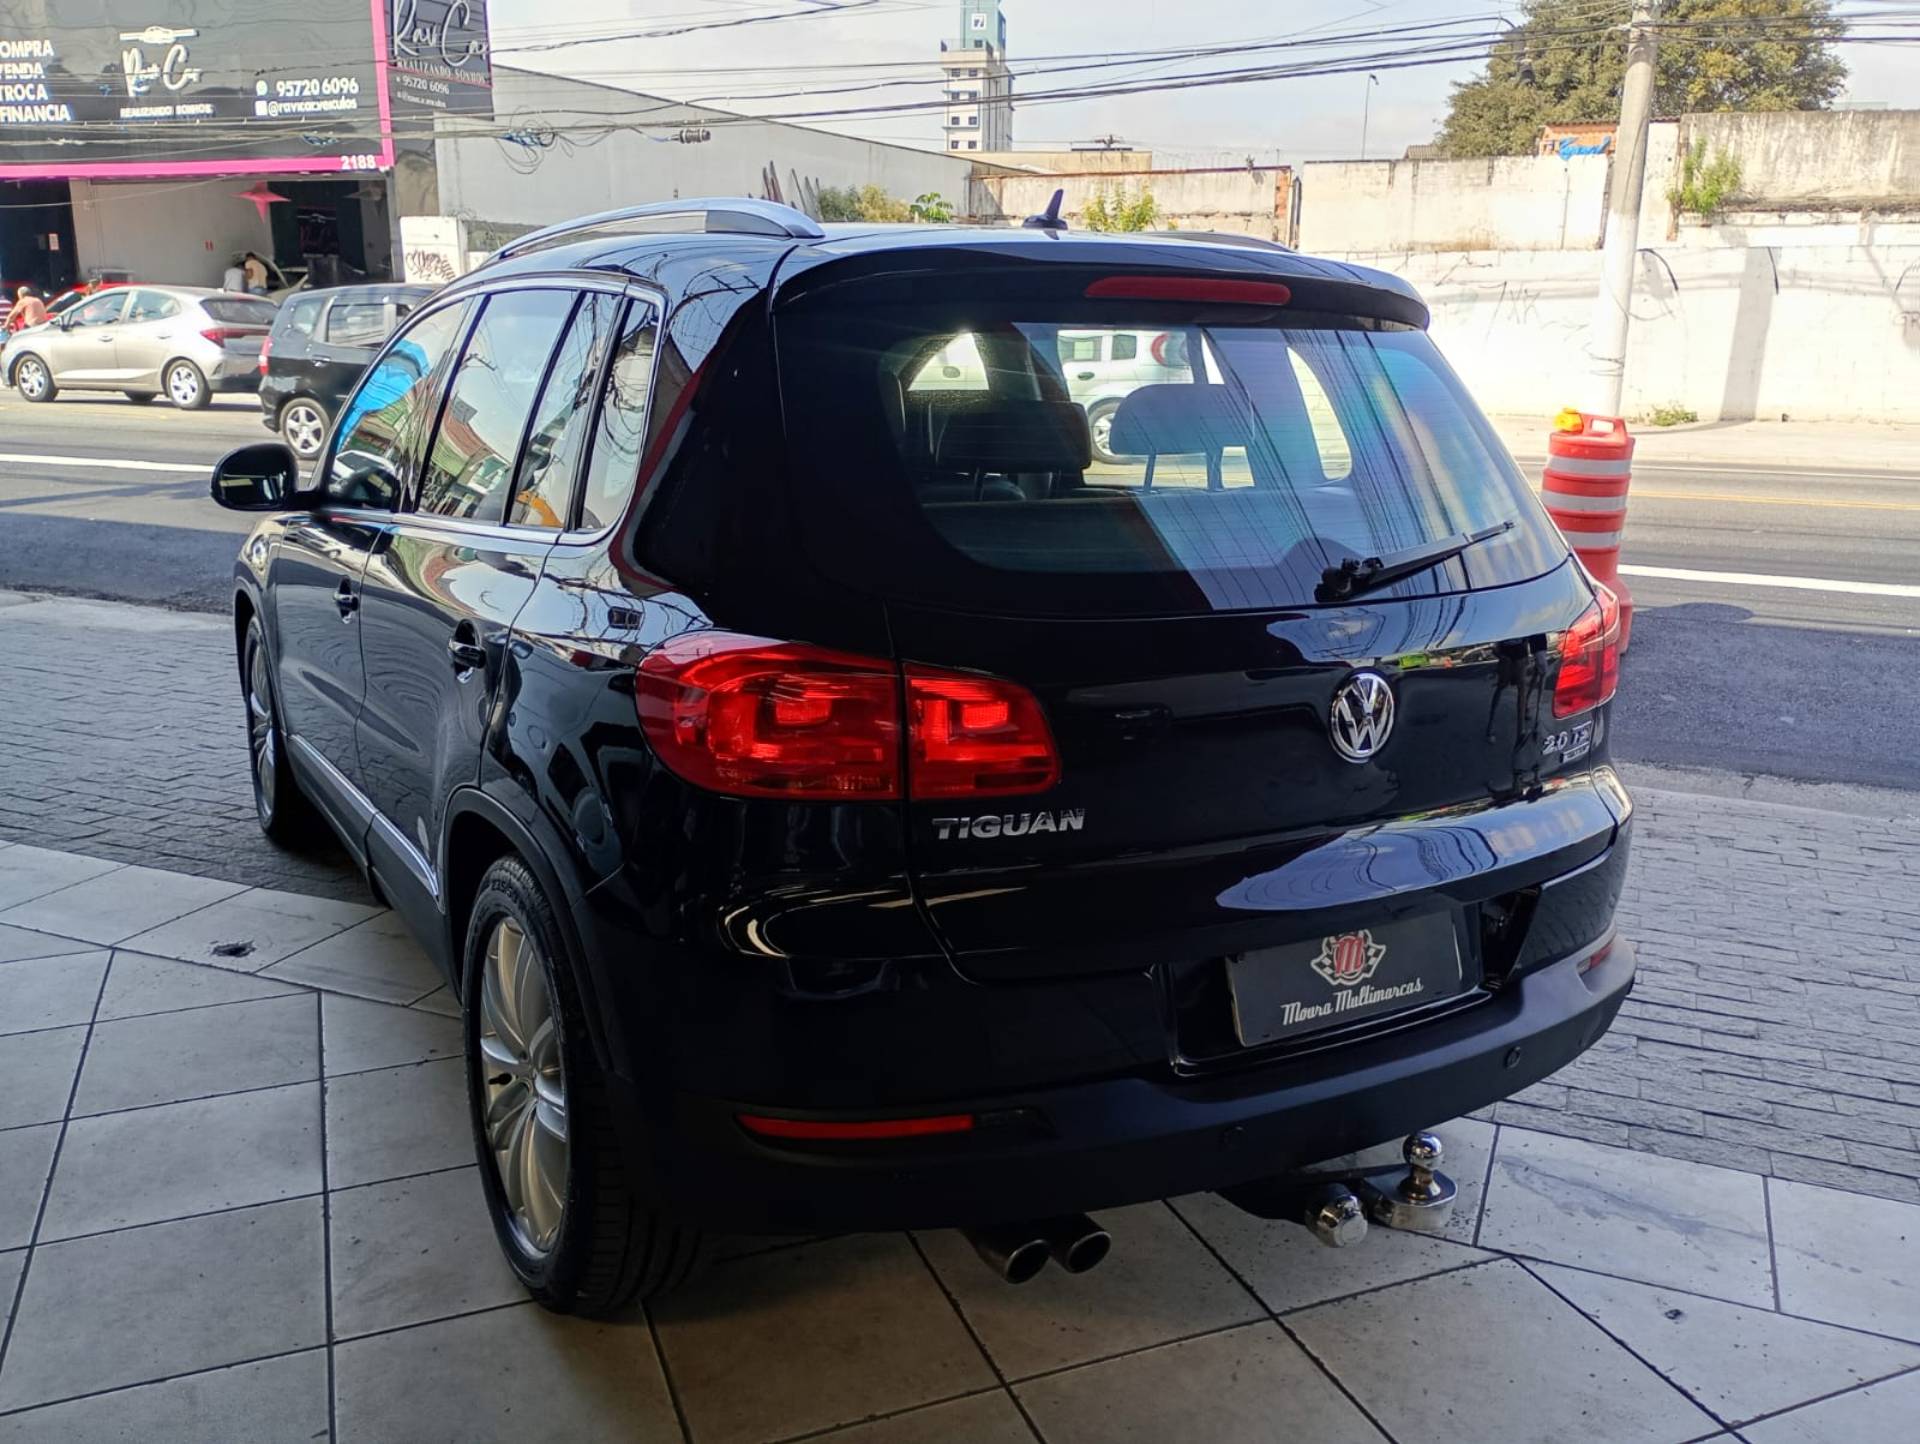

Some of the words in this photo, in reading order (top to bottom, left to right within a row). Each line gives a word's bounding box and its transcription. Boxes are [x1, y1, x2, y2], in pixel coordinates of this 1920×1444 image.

[0, 39, 54, 58] OMPRA
[276, 79, 320, 97] 95720
[321, 77, 360, 95] 6096
[0, 104, 71, 122] FINANCIA
[341, 154, 377, 170] 2188
[932, 808, 1085, 840] TIGUAN
[1280, 1001, 1333, 1026] Moura
[1333, 977, 1424, 1013] Multimarcas
